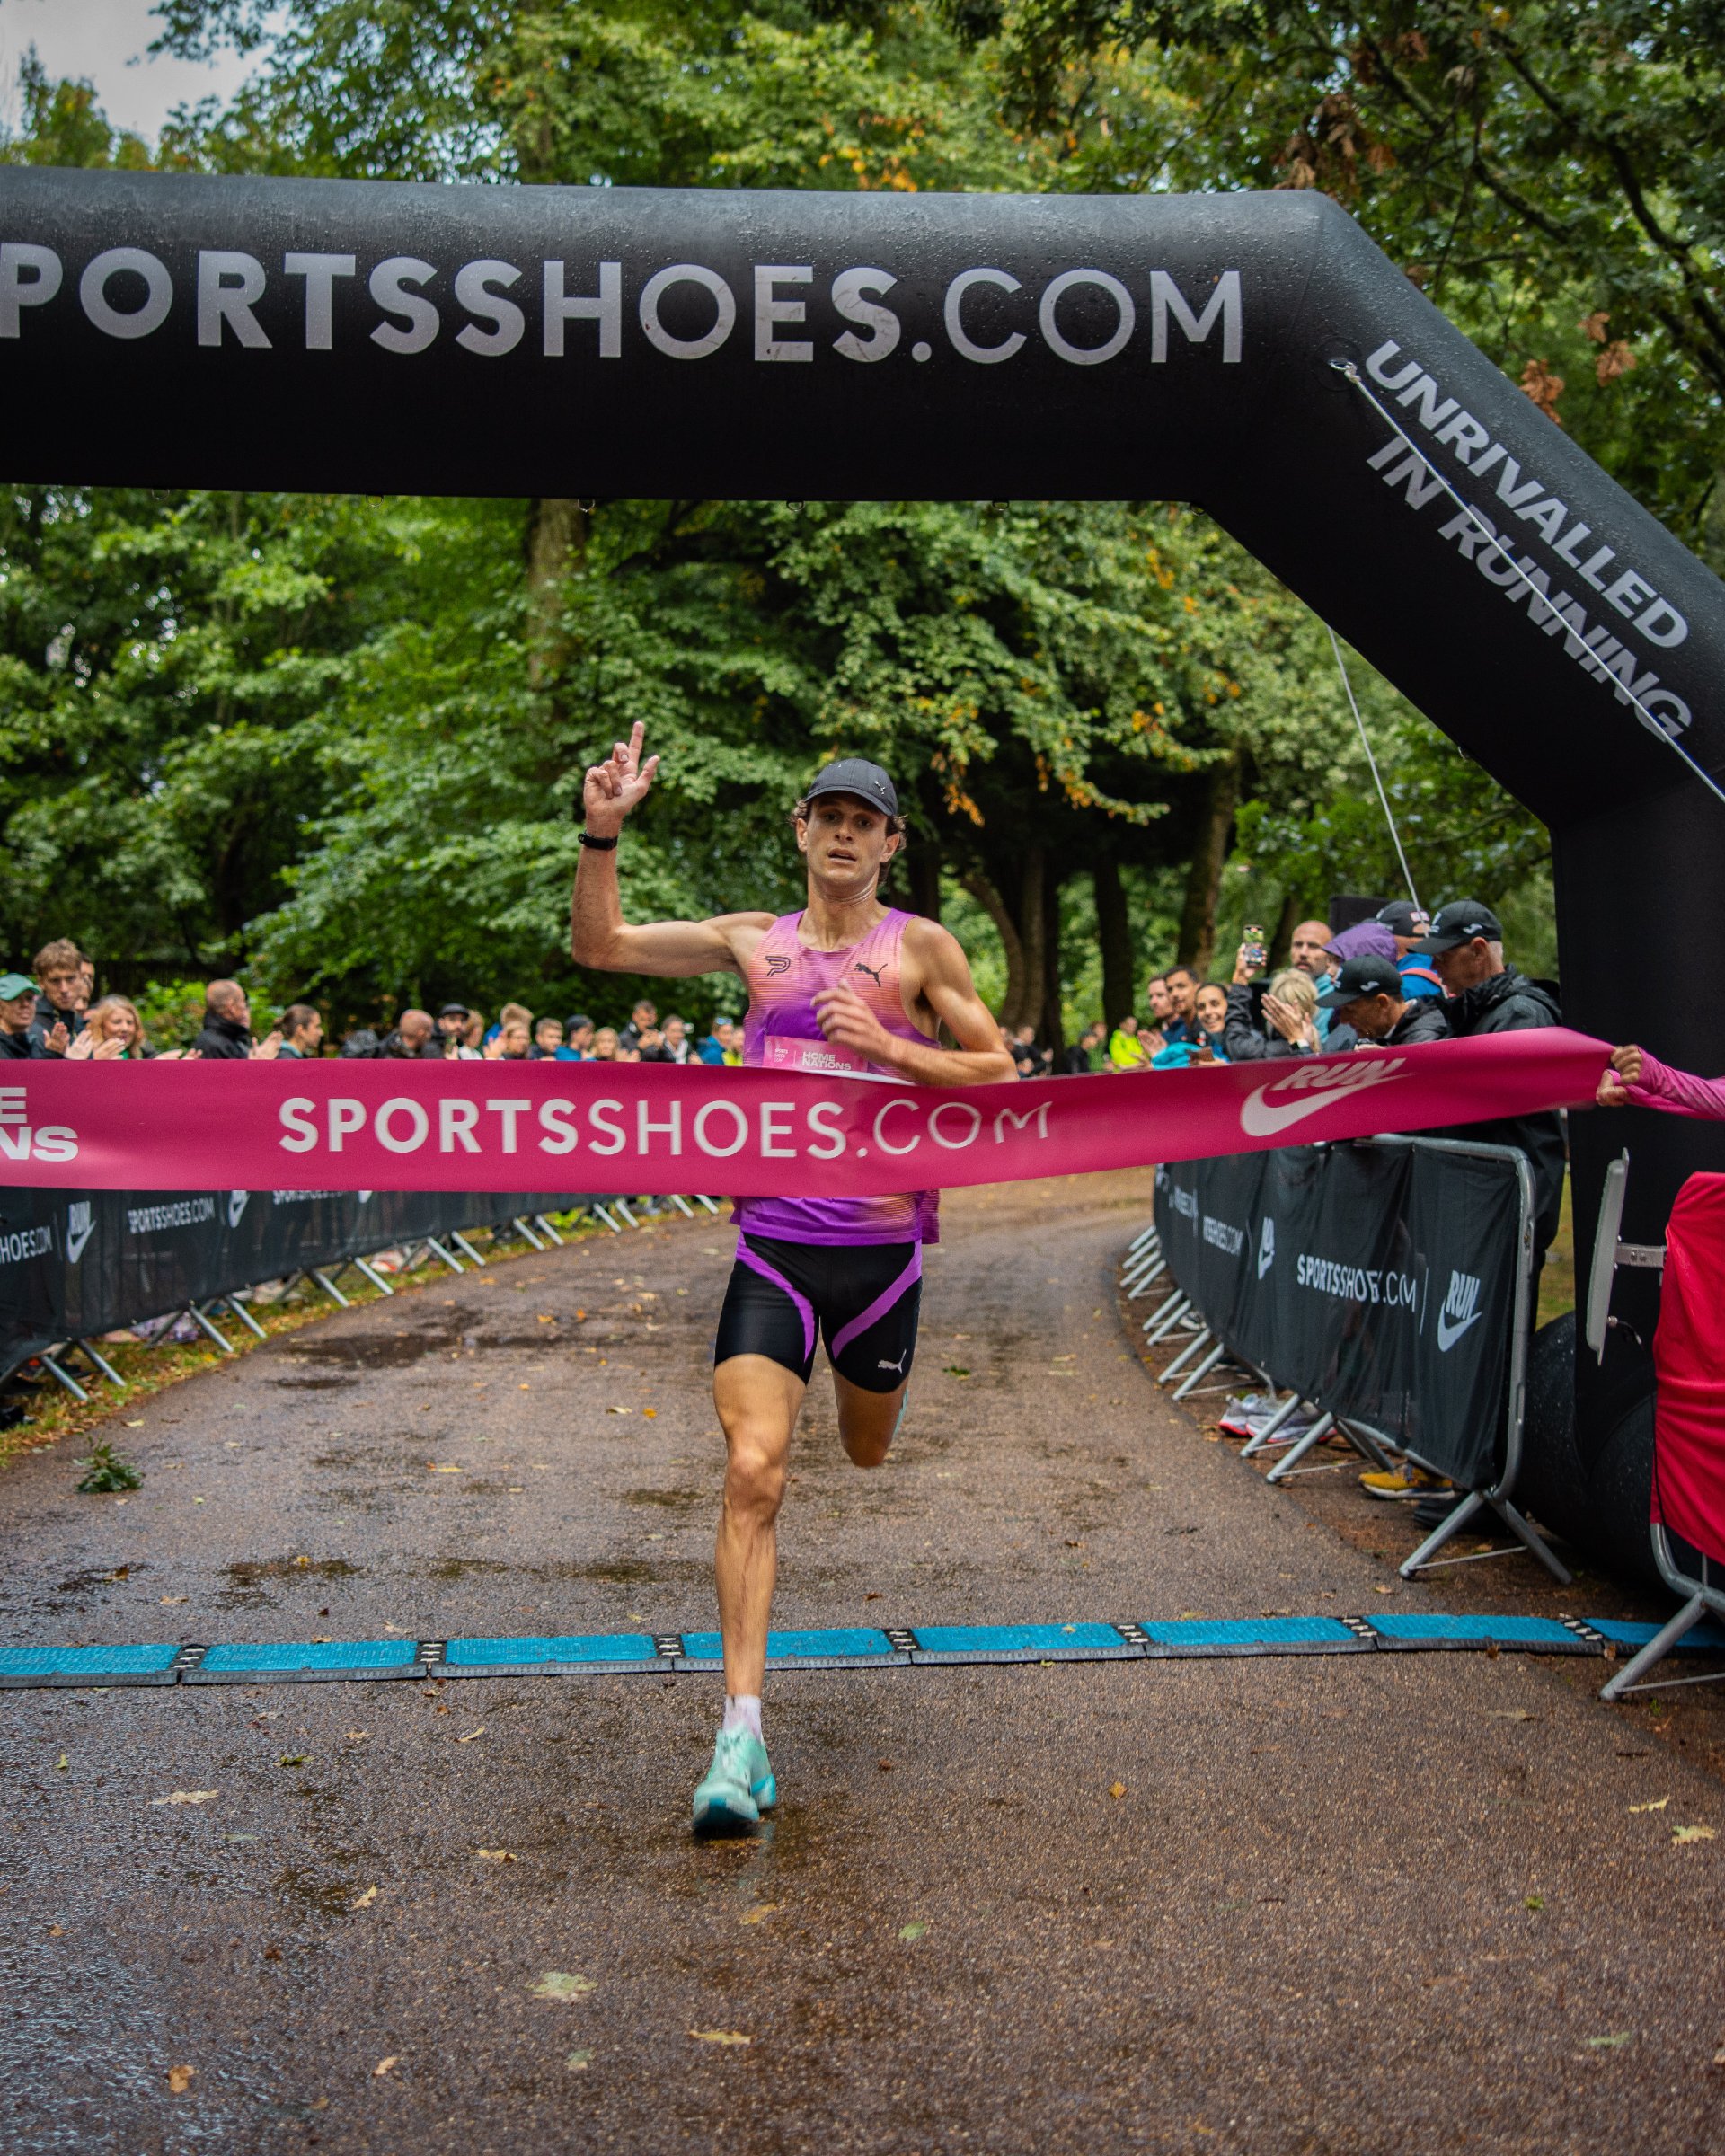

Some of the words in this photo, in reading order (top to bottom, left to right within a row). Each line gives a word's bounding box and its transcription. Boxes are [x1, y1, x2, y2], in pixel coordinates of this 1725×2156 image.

[1366, 340, 1689, 649] UNRIVALLED
[1366, 435, 1451, 510] IN
[1438, 503, 1693, 742] RUNNING
[801, 1051, 836, 1062] HOME
[801, 1057, 852, 1070] NATIONS
[1272, 1057, 1407, 1091] RUN
[279, 1096, 1053, 1160] SPORTSSHOES.COM
[1445, 1269, 1481, 1321] RUN
